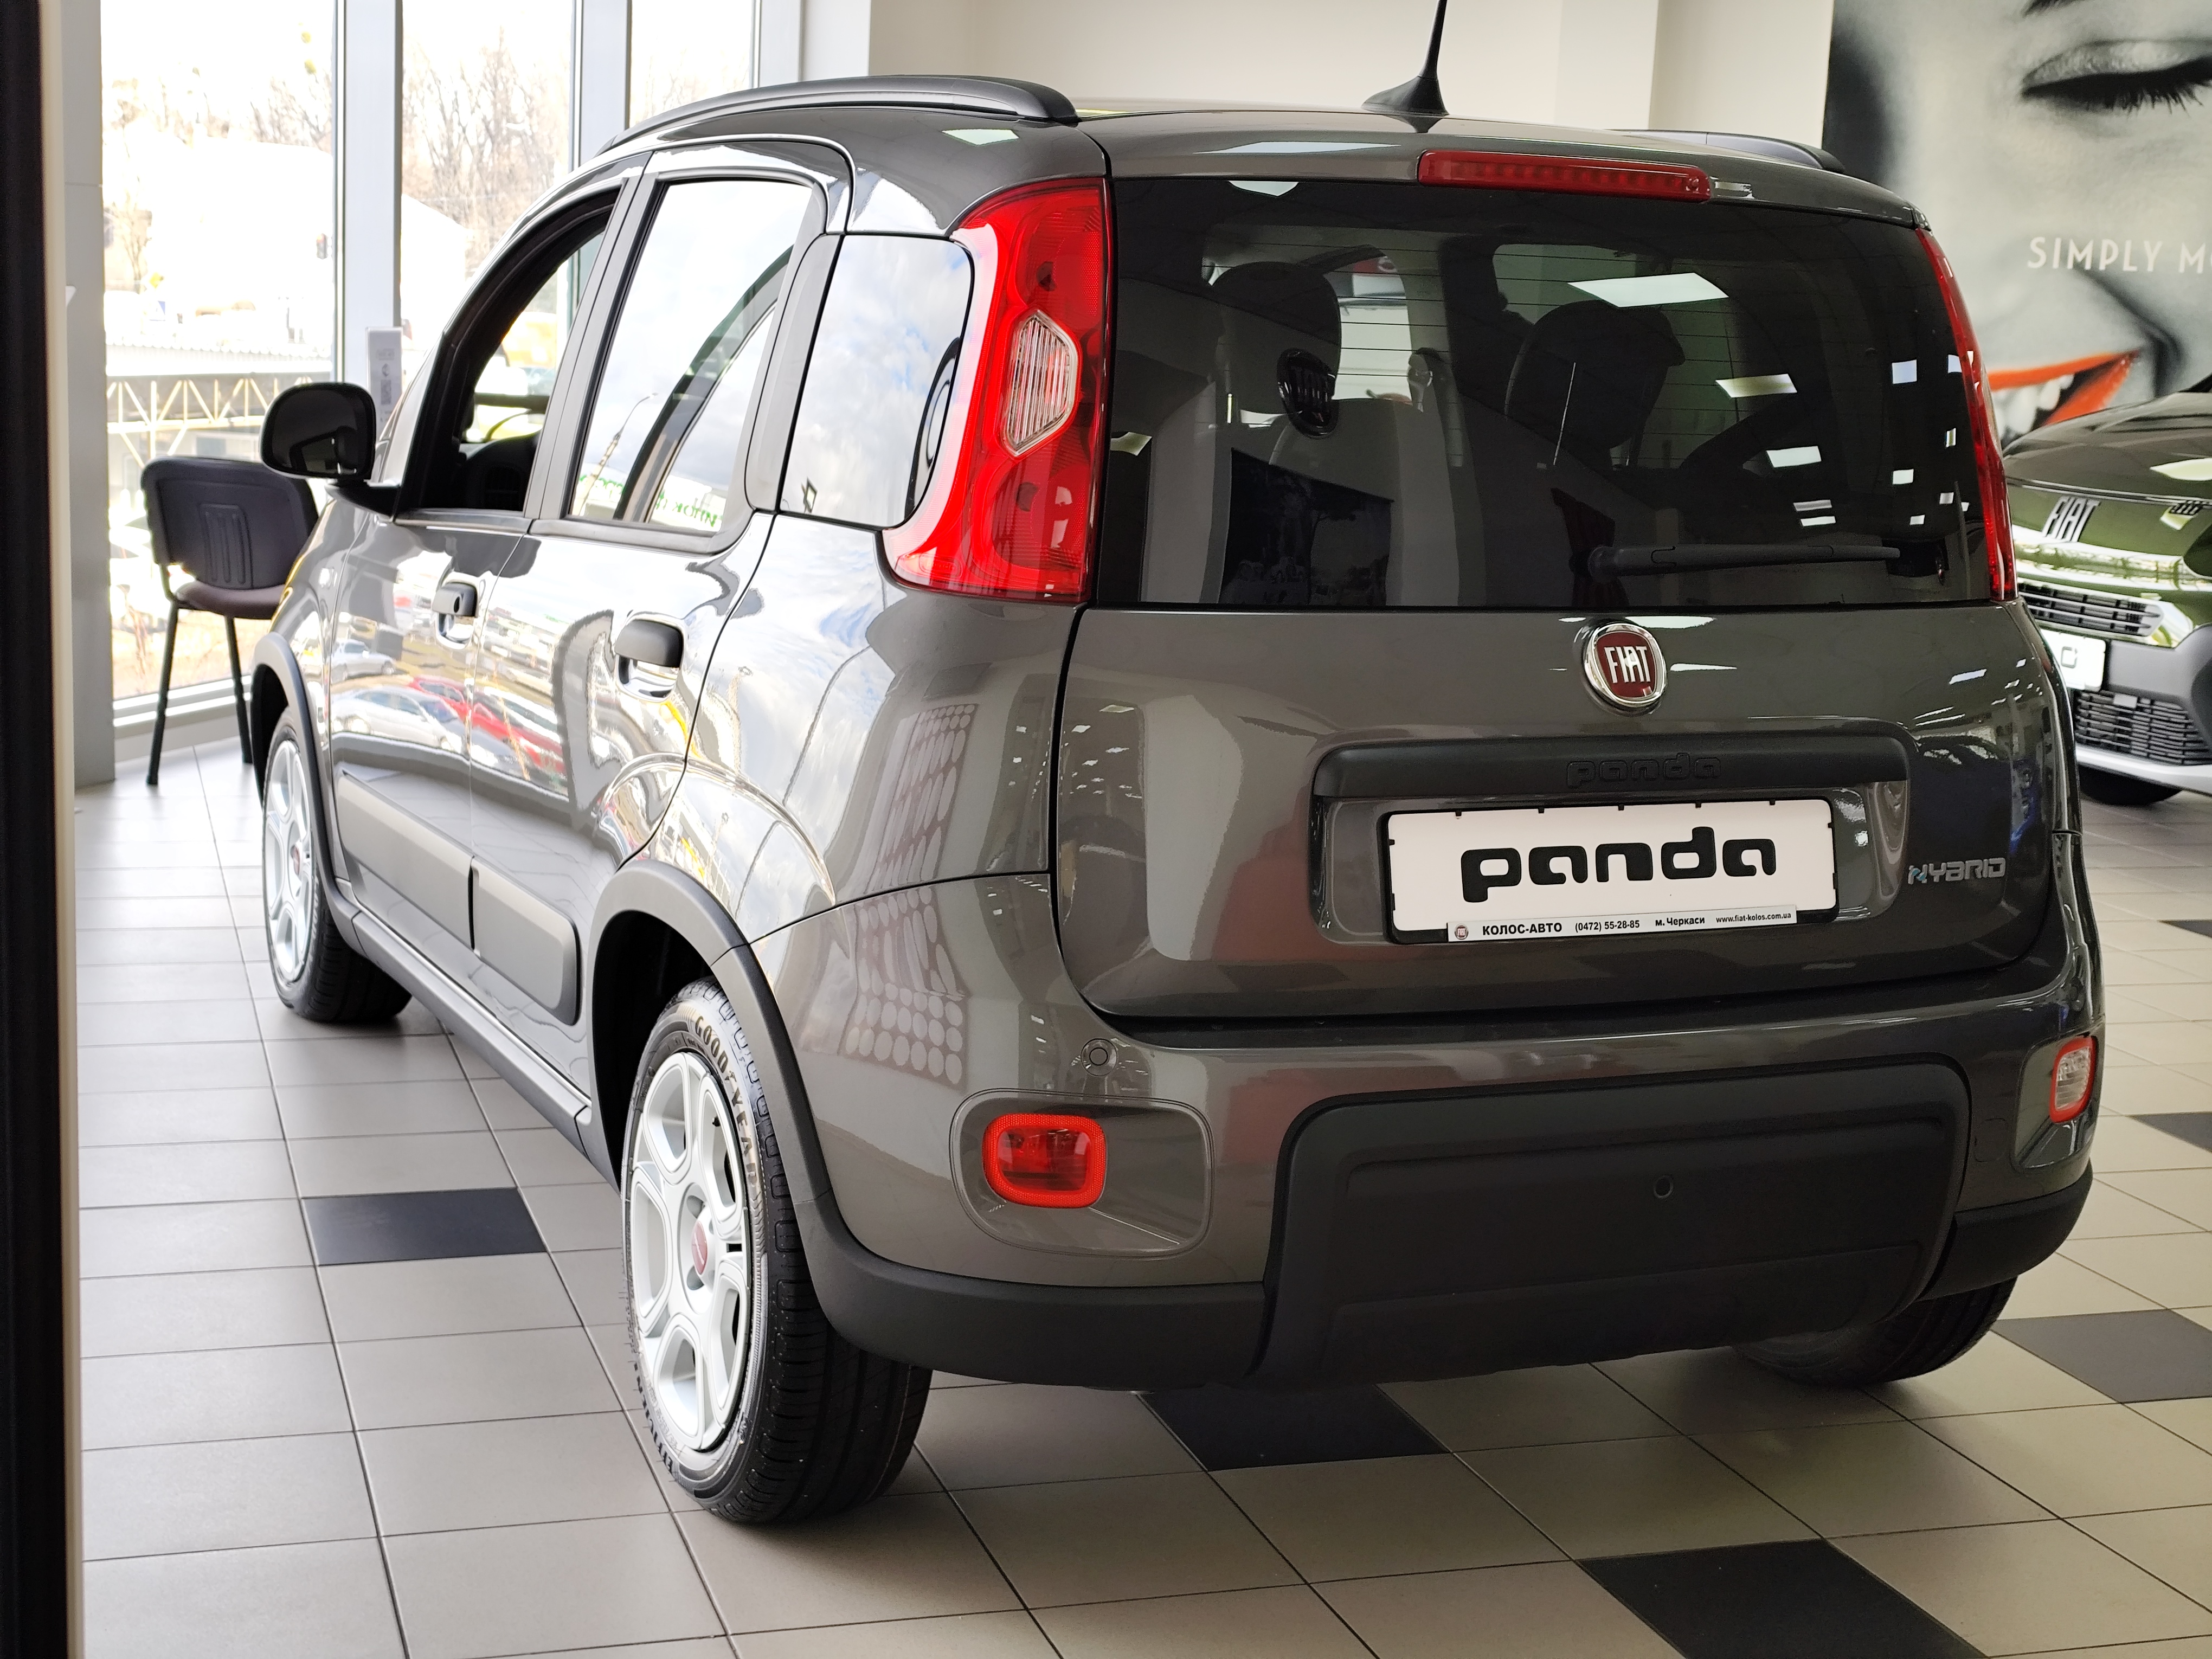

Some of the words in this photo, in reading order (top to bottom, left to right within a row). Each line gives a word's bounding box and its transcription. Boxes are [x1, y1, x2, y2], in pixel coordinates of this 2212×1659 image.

[2027, 237, 2163, 273] SIMPLY
[2178, 242, 2212, 274] M
[2040, 496, 2101, 543] FIAT
[1604, 646, 1651, 684] FIAT
[1567, 753, 1721, 788] panda
[1461, 826, 1776, 903] panda
[1908, 857, 2005, 885] HYBRID
[1482, 923, 1562, 935] КОЛОС-АВТО
[1575, 921, 1602, 933] (0472)
[1604, 919, 1639, 930] 55-28-85
[1667, 917, 1705, 926] Черкаси
[1716, 912, 1791, 923] www.fiat-kolos.com.ua
